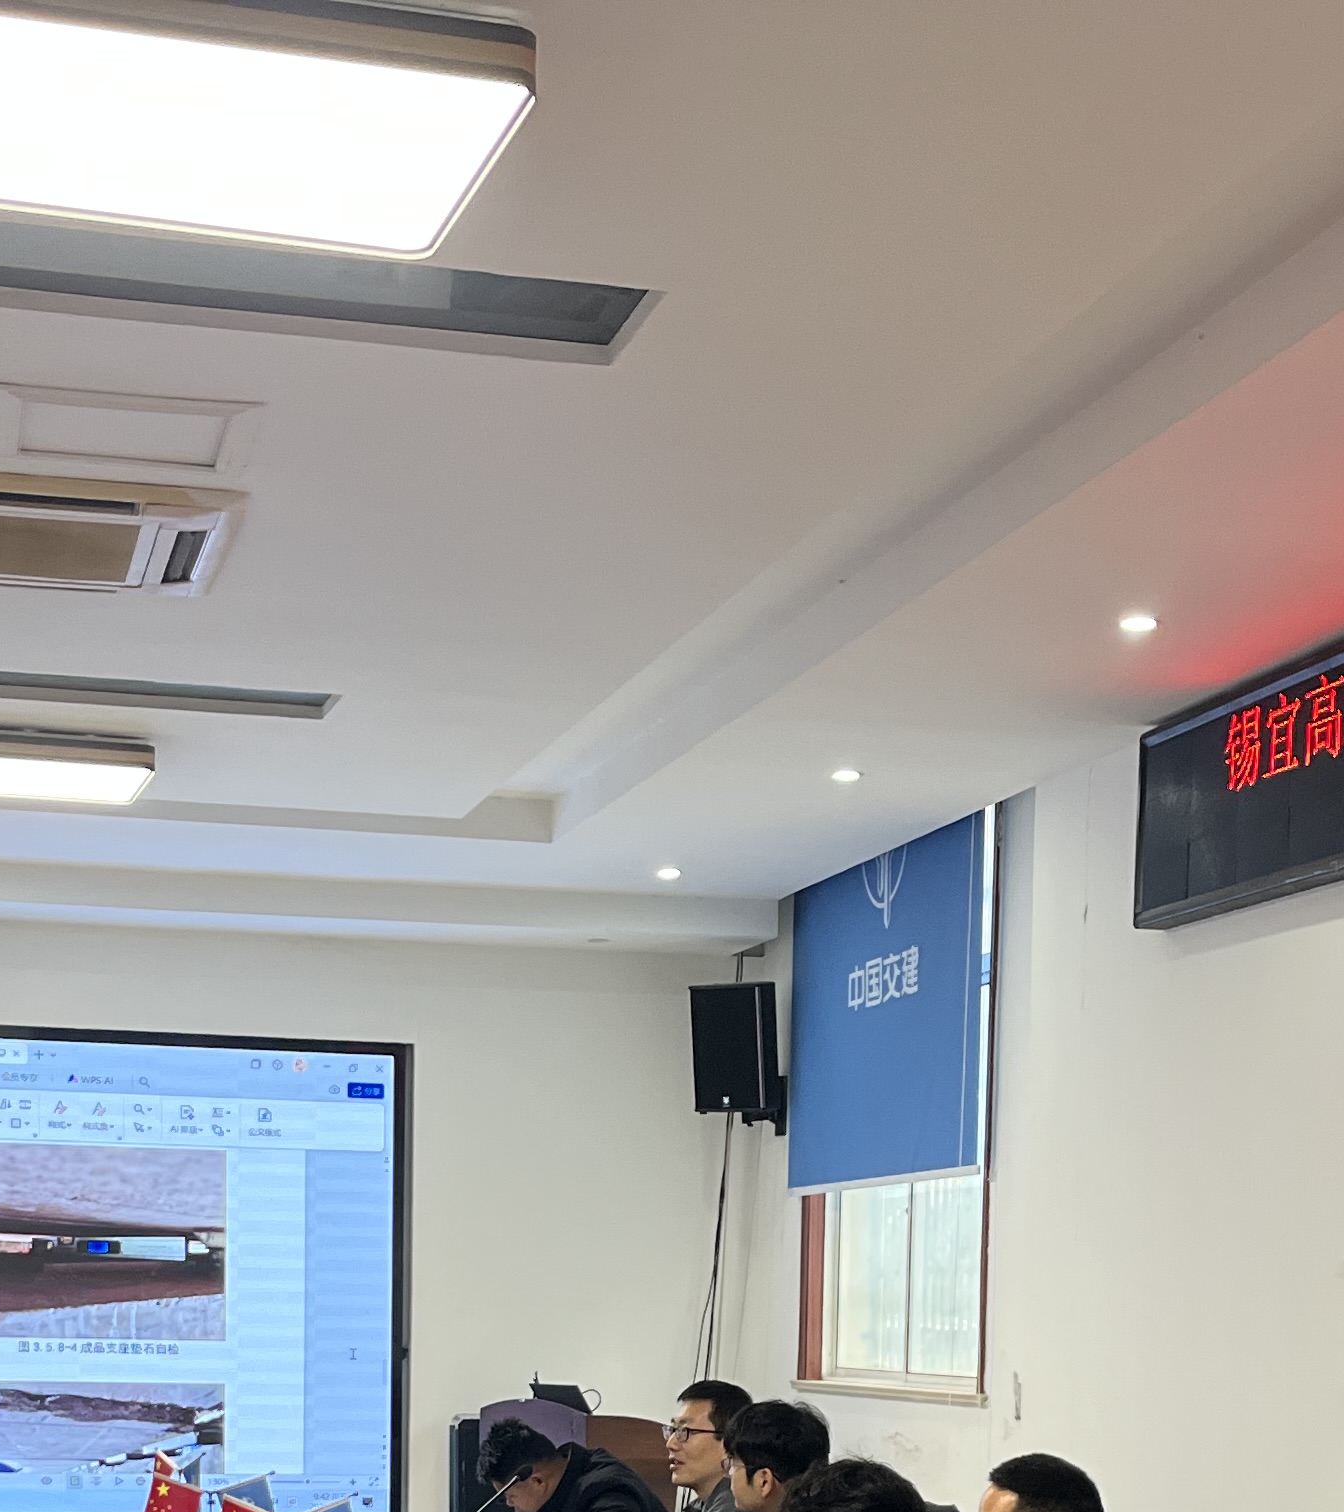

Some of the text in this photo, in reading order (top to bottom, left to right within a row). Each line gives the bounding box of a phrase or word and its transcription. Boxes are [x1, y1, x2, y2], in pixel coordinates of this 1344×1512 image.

[847, 945, 920, 1012] 中国交建
[81, 1075, 103, 1085] WPS
